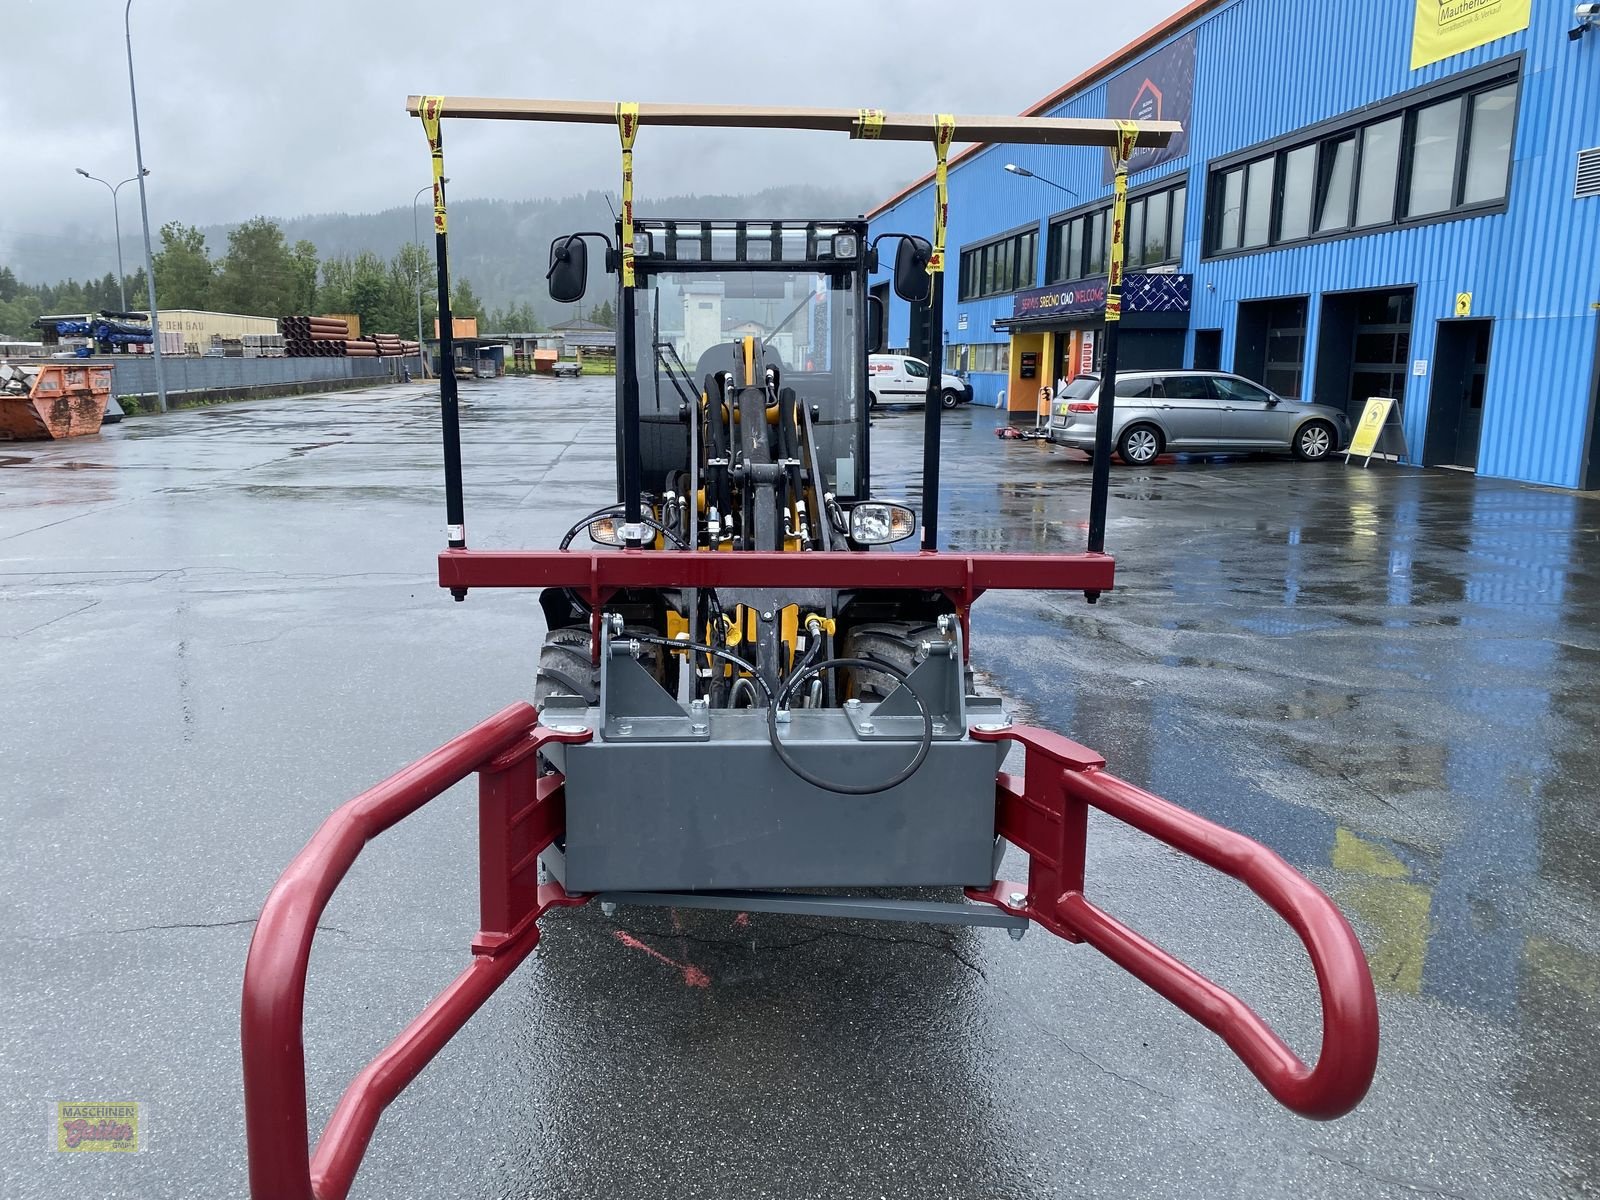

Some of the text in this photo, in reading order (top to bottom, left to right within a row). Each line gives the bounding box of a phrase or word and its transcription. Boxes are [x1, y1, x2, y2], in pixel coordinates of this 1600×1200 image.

[1021, 287, 1105, 310] SERVUS SREČNO CIAO WELCOME
[166, 321, 183, 331] DEN
[186, 321, 204, 331] BAU
